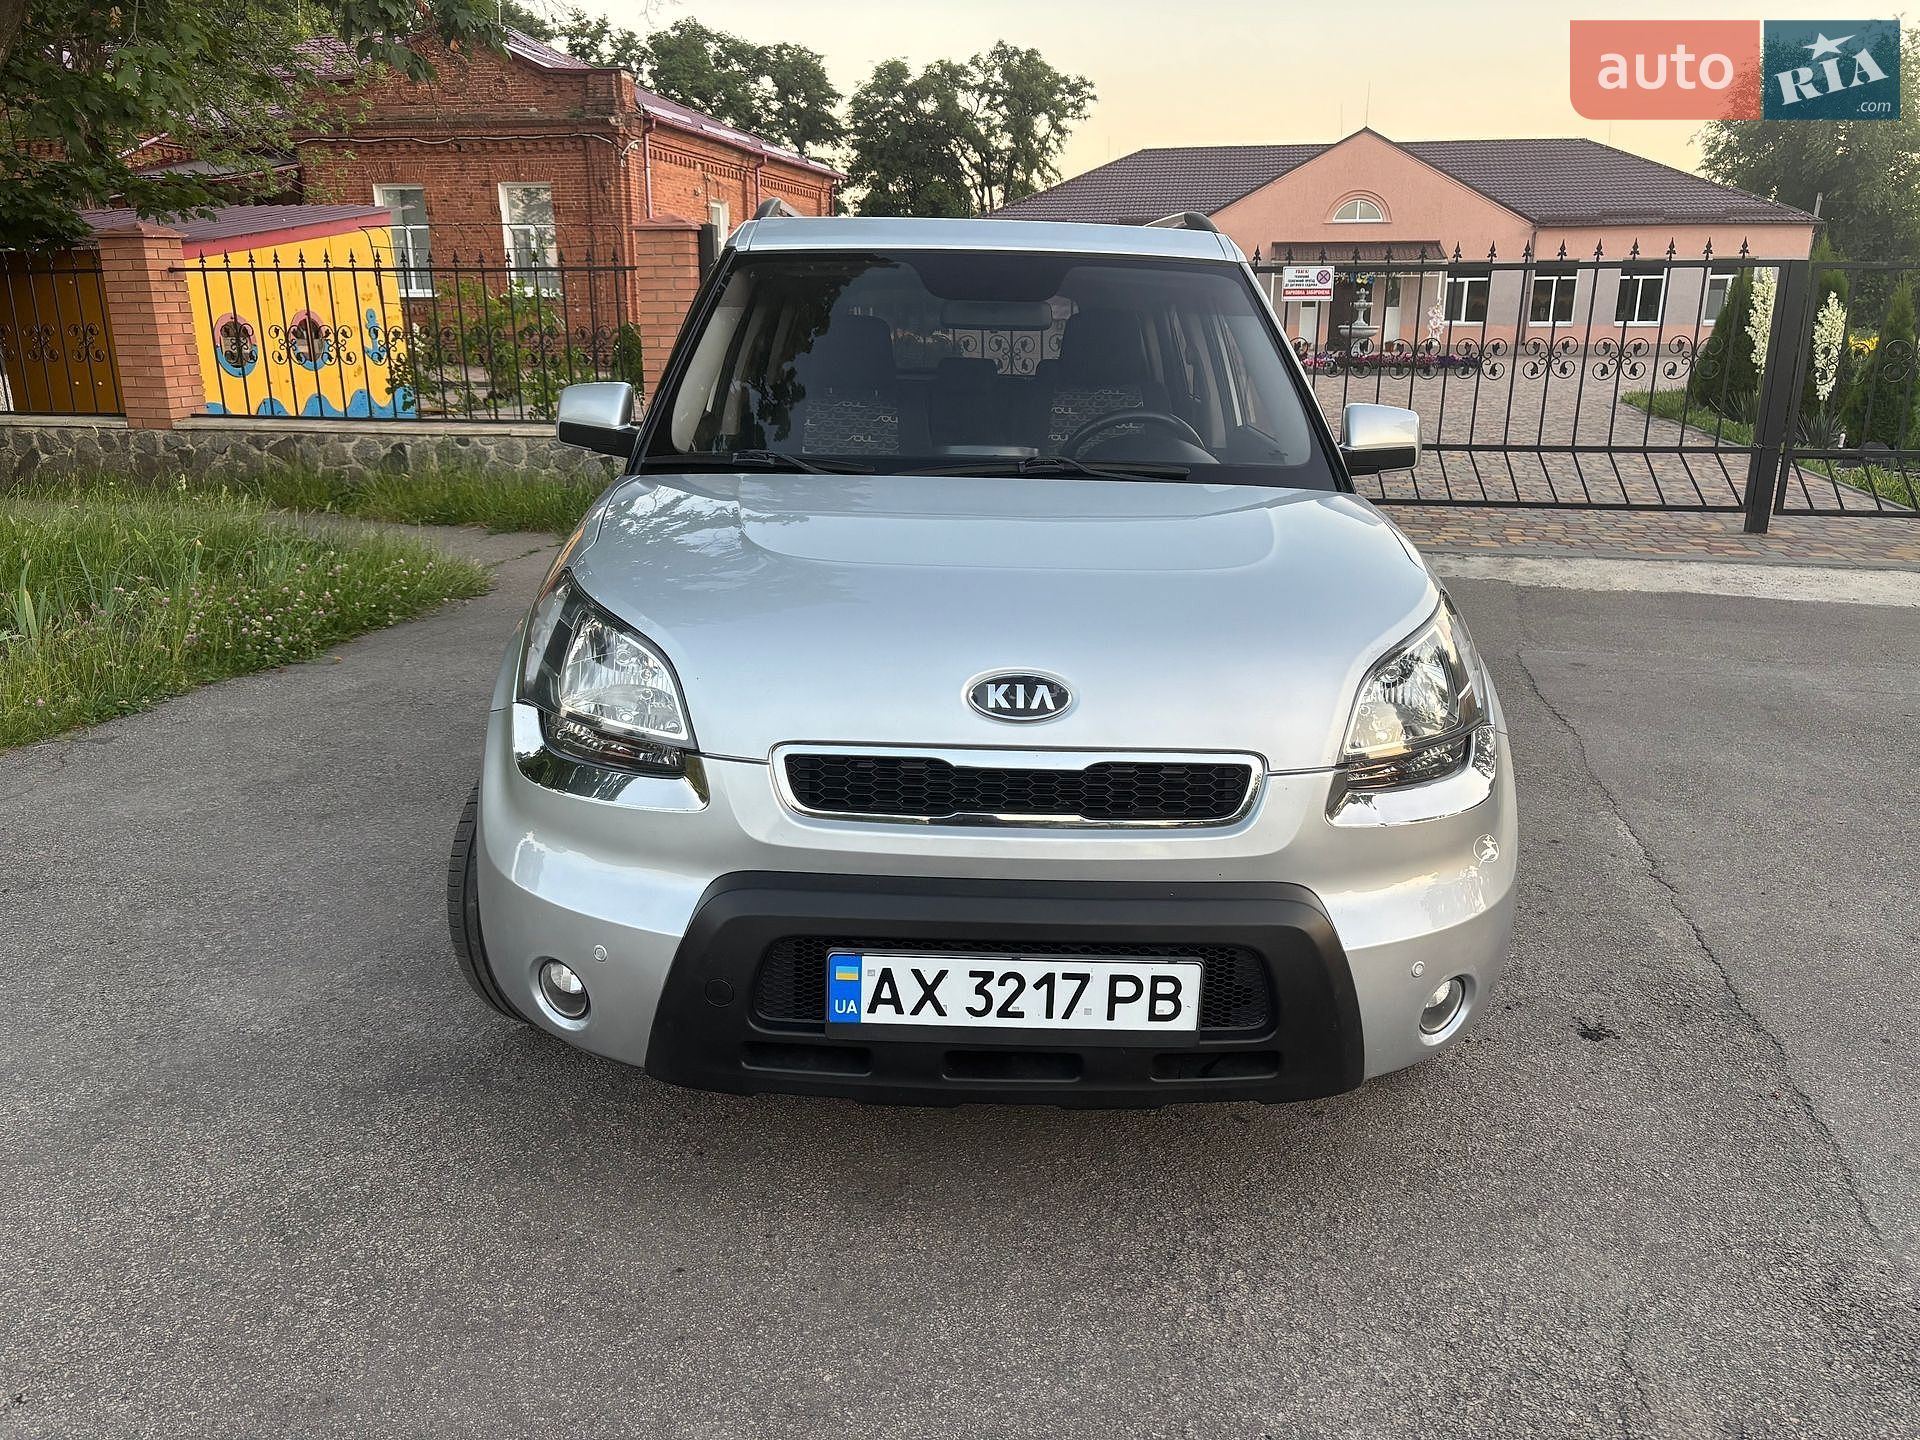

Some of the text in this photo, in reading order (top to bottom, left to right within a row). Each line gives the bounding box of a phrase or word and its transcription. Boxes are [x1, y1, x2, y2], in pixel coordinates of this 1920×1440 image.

[986, 683, 1056, 710] KIA
[834, 999, 858, 1014] UA
[866, 967, 1183, 1022] AX 3217 PB
